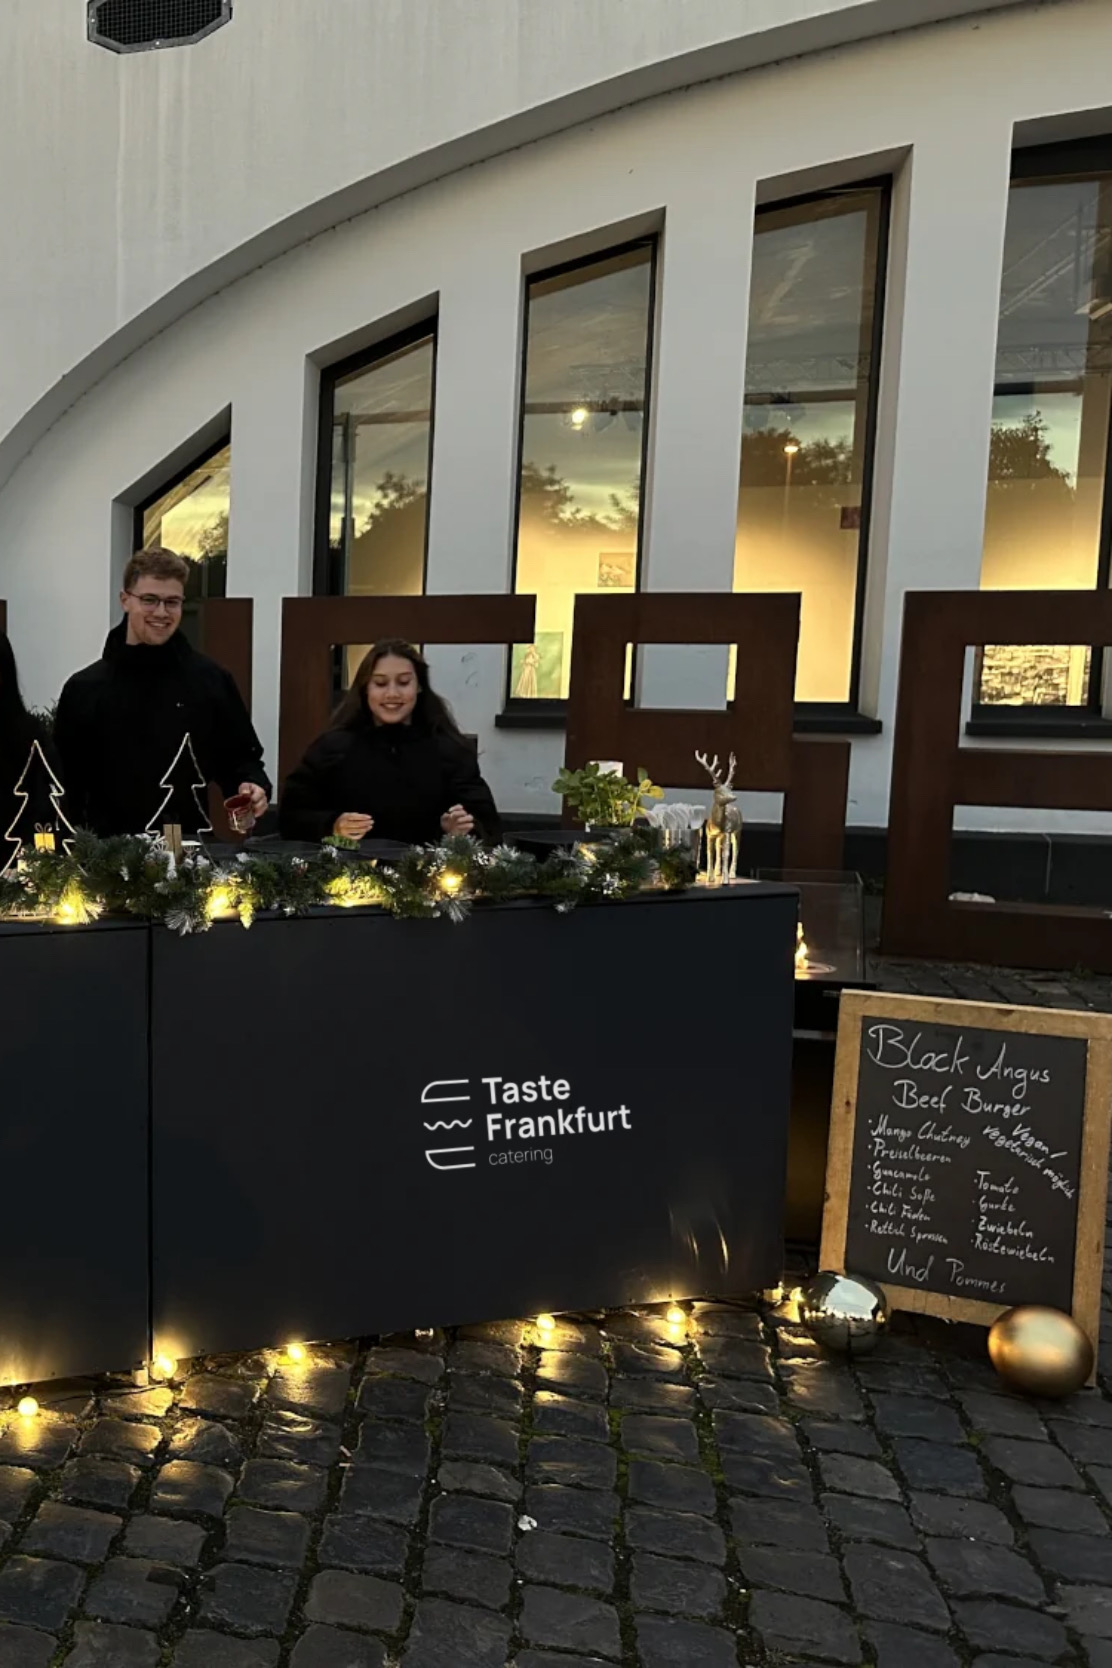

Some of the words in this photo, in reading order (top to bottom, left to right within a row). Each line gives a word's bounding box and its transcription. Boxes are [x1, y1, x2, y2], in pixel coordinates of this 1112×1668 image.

[867, 1025, 970, 1074] Black
[976, 1042, 1051, 1099] Angus
[482, 1076, 571, 1104] Taste
[892, 1079, 953, 1114] Beef
[960, 1087, 1032, 1118] Burger
[487, 1105, 632, 1141] Frankfurt
[871, 1114, 912, 1142] Mango
[488, 1147, 553, 1165] catering
[872, 1181, 903, 1198] Chili
[976, 1170, 1020, 1195] Tomate
[869, 1200, 897, 1216] Chili
[979, 1195, 1016, 1214] Gurke
[978, 1215, 1034, 1239] Zwiebeln
[887, 1247, 935, 1282] Und
[945, 1258, 1007, 1294] Pommes
